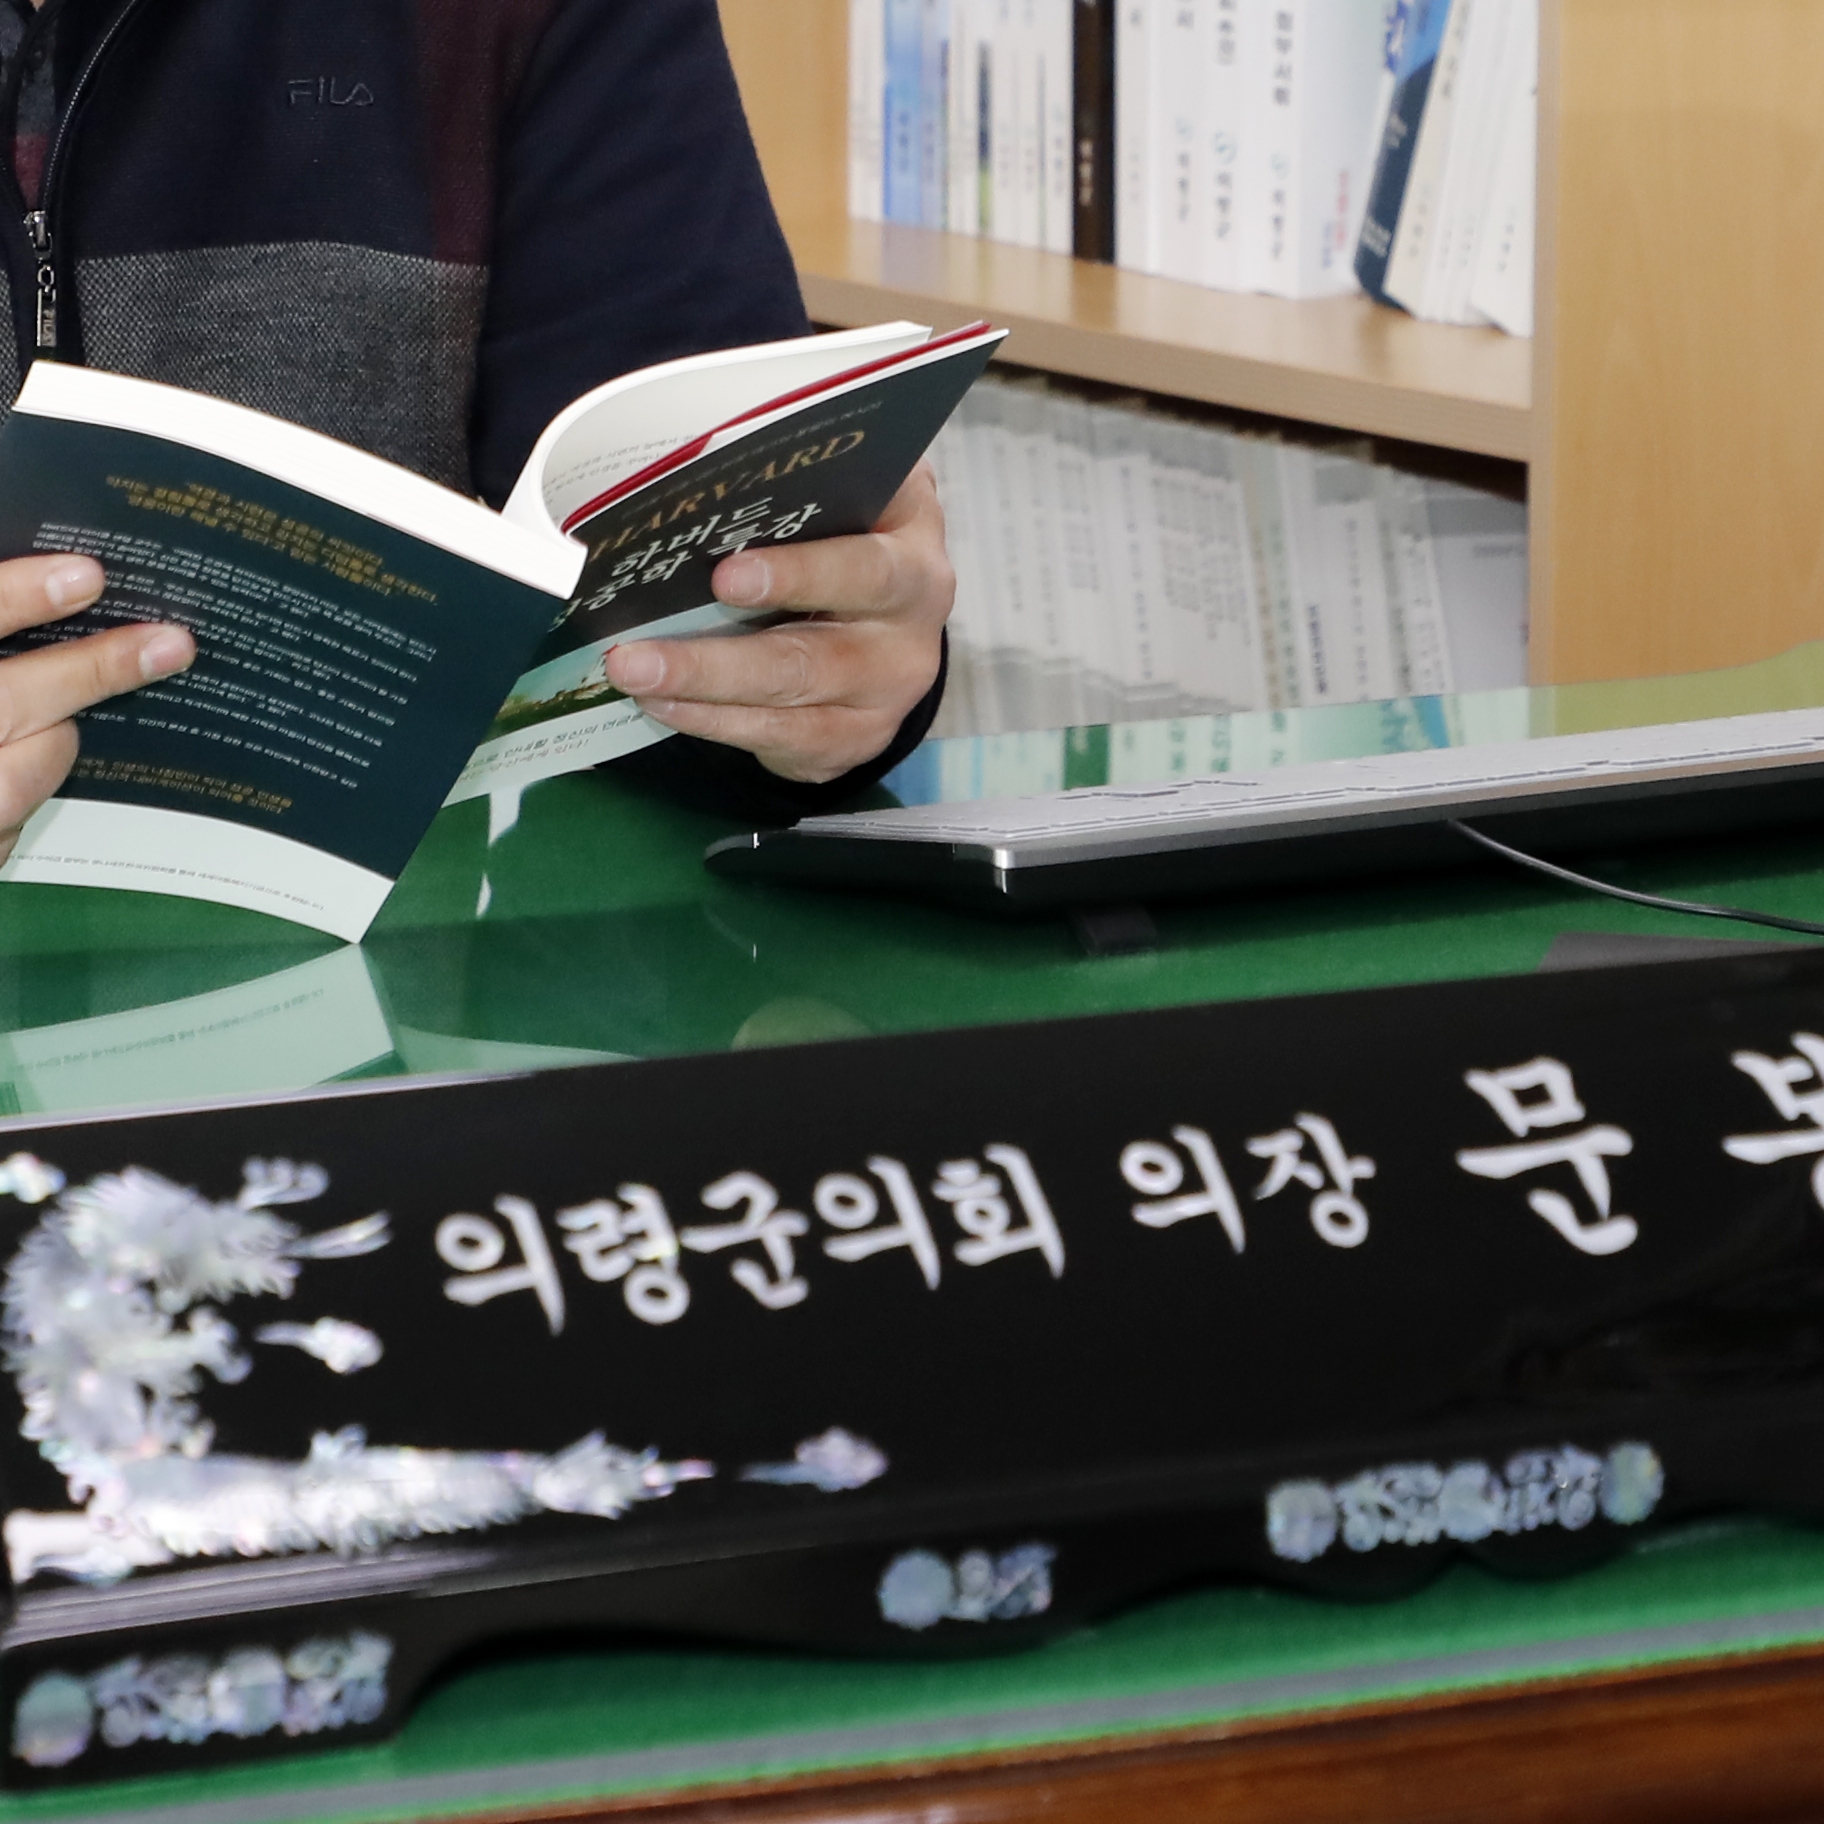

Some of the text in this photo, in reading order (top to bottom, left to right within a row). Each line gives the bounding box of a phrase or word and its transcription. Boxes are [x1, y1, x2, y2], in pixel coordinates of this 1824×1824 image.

[287, 75, 375, 107] FILA
[588, 430, 866, 564] HARVARD
[611, 495, 774, 578] 하버드
[708, 501, 824, 558] 특강
[430, 1140, 1072, 1339] 의령군의회
[1116, 1110, 1379, 1258] 의장
